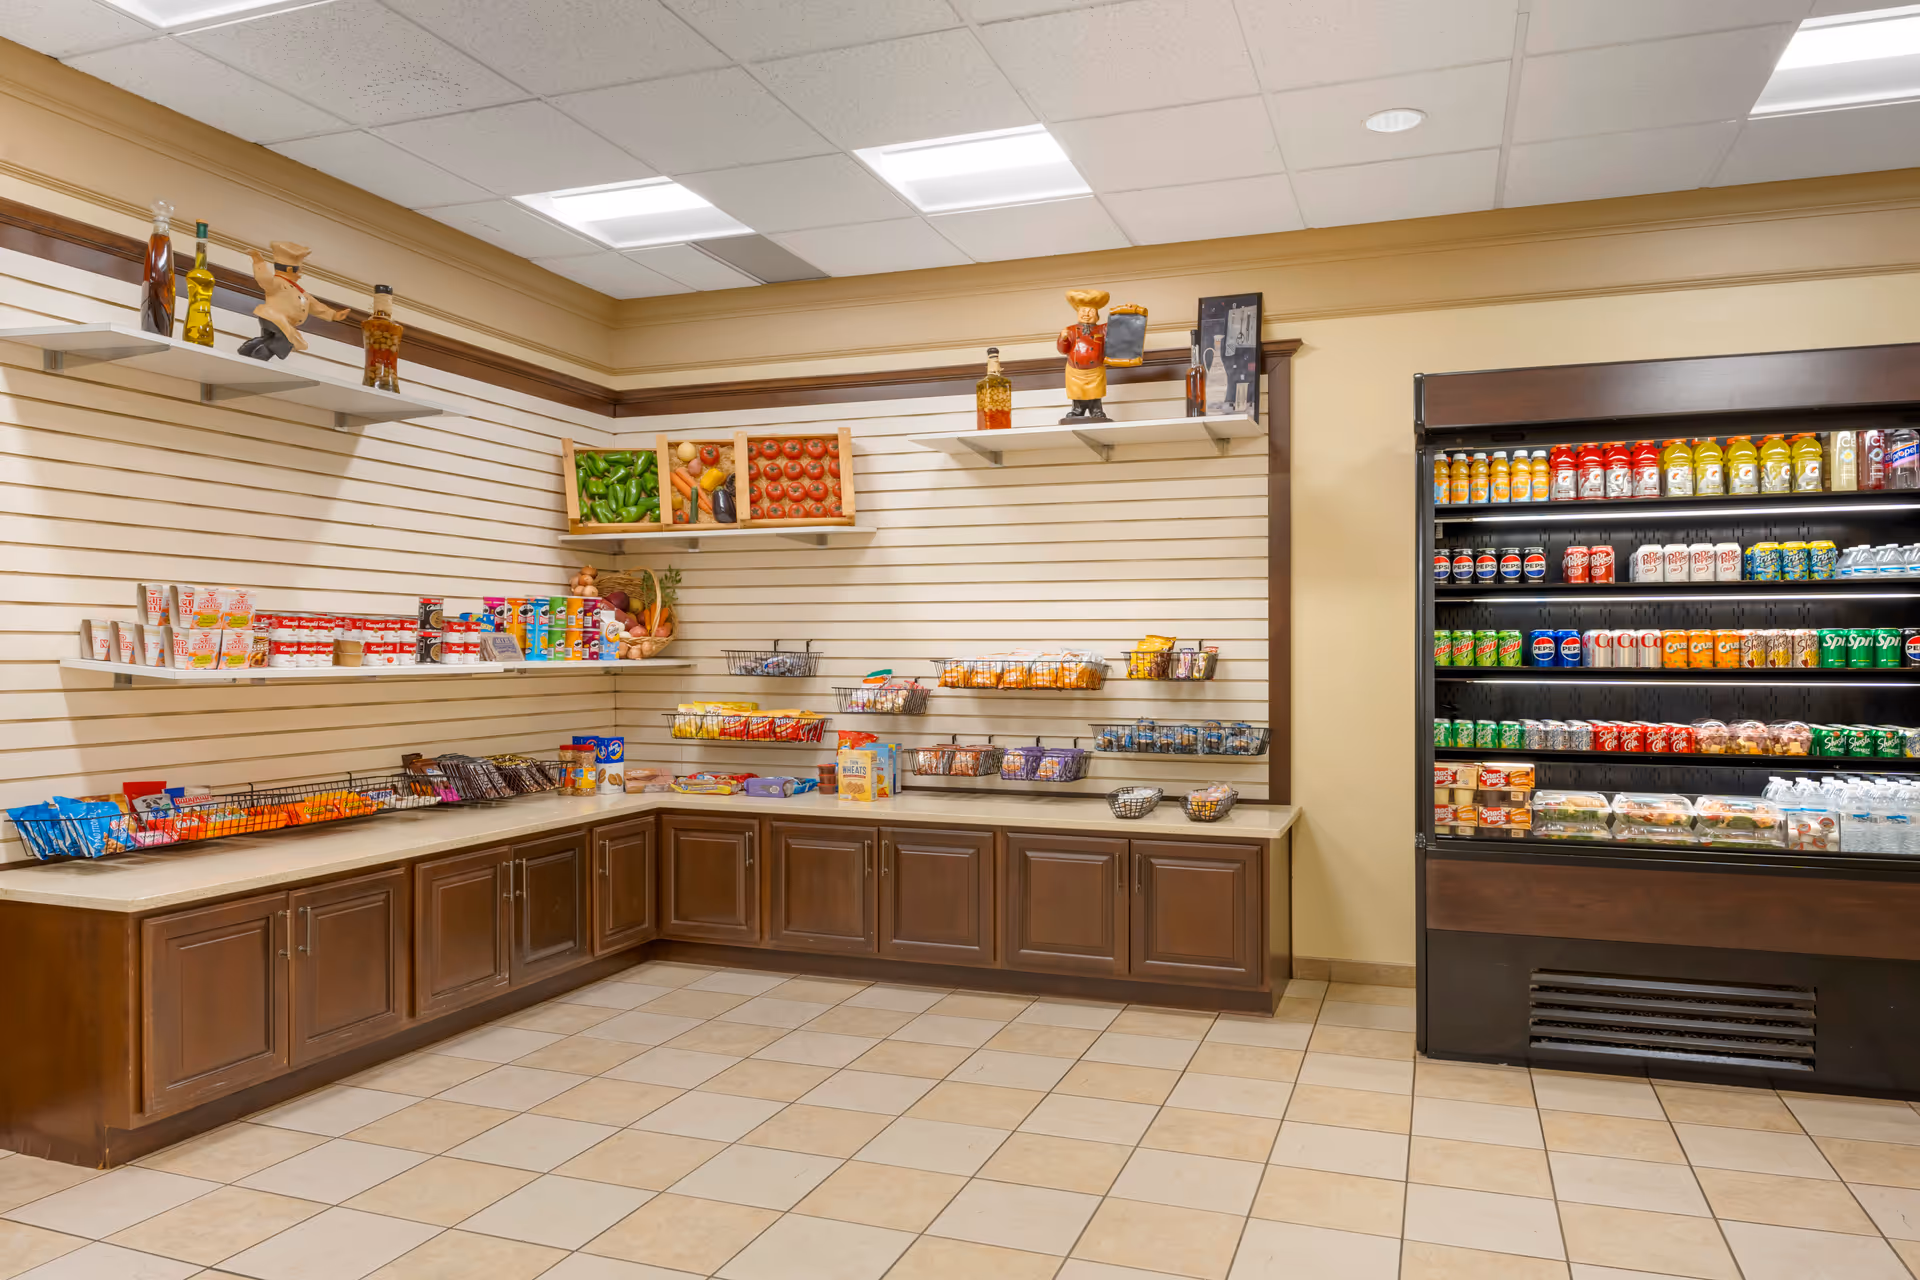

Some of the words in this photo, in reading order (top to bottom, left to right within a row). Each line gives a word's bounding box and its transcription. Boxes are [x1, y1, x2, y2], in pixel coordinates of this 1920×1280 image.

[1893, 445, 1917, 461] propel
[1641, 554, 1663, 565] Pepper
[1667, 554, 1688, 565] Pepper
[1692, 553, 1715, 564] Pepper
[1718, 552, 1740, 564] Pepper
[1756, 552, 1777, 565] Brisk
[1784, 552, 1805, 565] Brisk
[1812, 552, 1834, 564] Brisk
[1605, 739, 1618, 750] Cola
[1624, 740, 1639, 751] Cola
[1652, 740, 1667, 752] Cola
[1673, 740, 1687, 752] Cola
[842, 766, 867, 776] WHEATS
[1481, 771, 1506, 779] Snack
[1487, 777, 1506, 786] pack
[1481, 809, 1507, 817] Snack
[1487, 814, 1506, 823] pack
